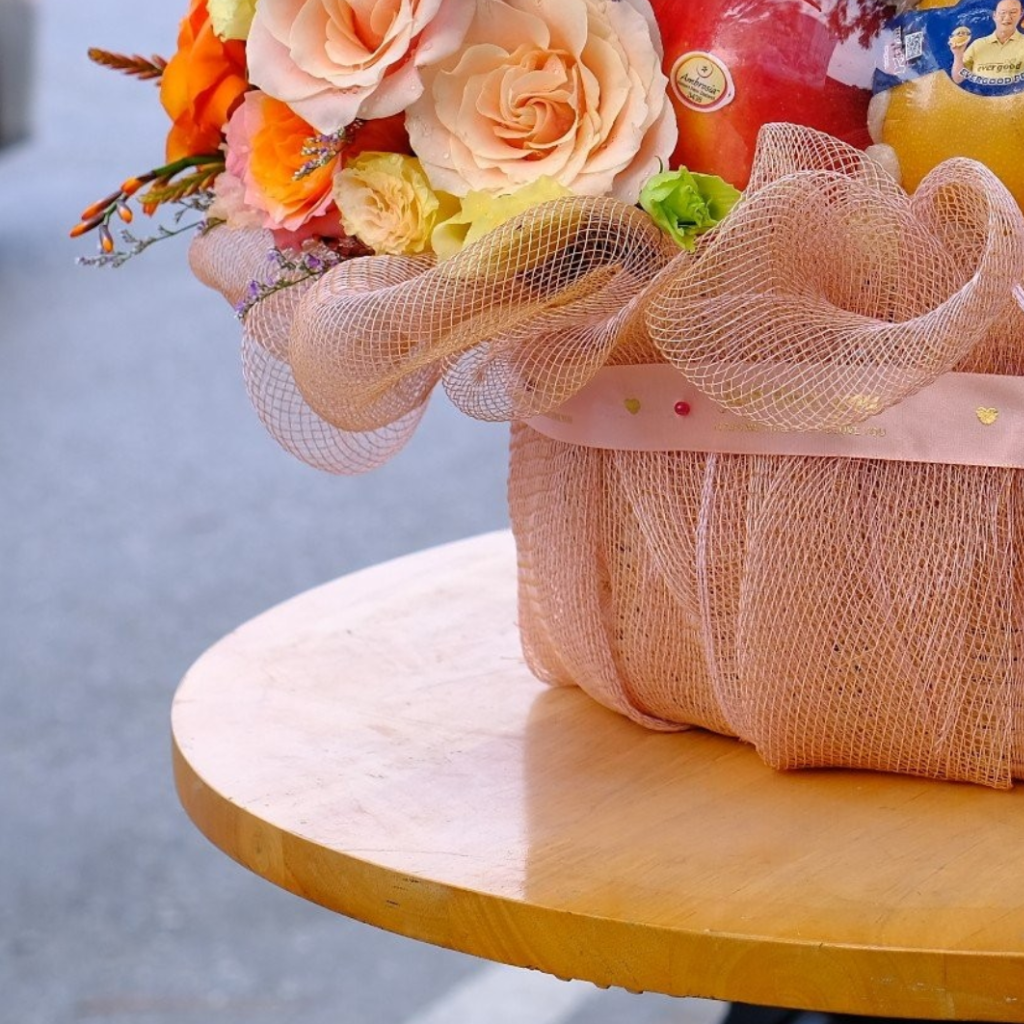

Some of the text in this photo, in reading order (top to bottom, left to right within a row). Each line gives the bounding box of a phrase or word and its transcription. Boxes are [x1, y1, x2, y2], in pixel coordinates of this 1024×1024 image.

[960, 67, 1012, 86] EVERGOOD
[977, 61, 1023, 73] evergood
[680, 73, 717, 95] Ambrosia
